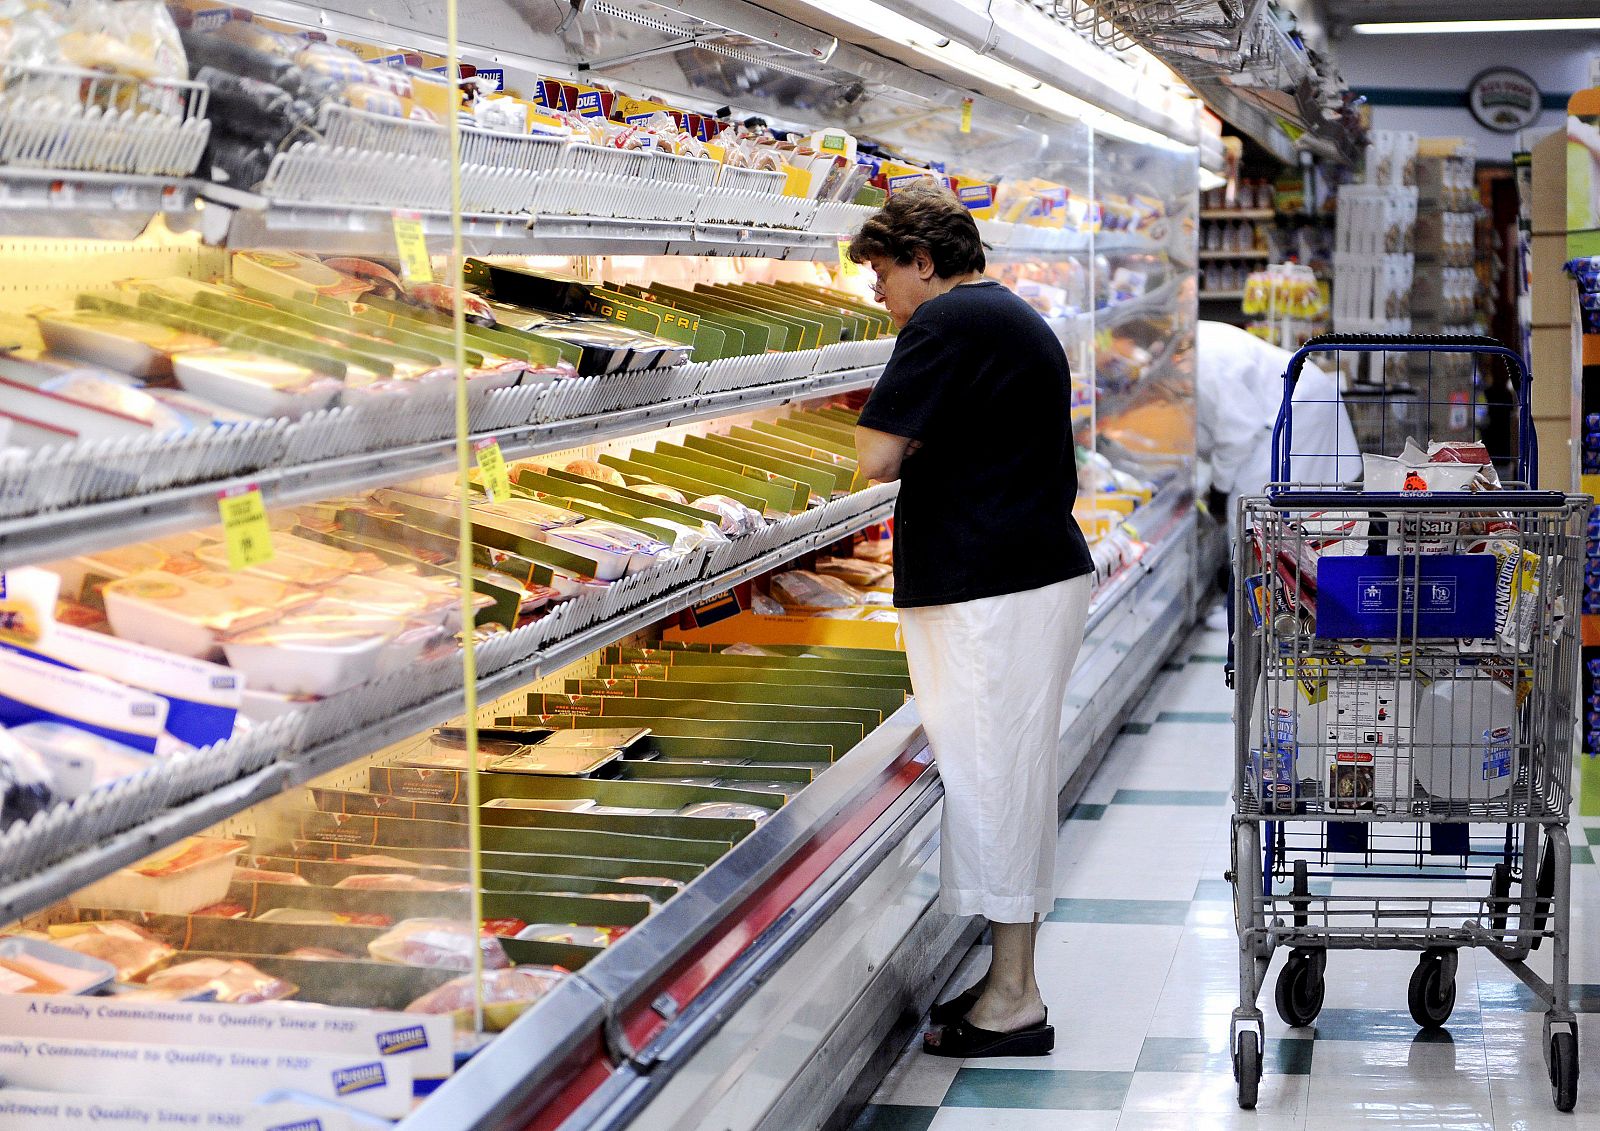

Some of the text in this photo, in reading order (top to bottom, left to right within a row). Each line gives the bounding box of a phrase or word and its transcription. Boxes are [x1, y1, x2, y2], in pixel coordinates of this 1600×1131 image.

[27, 1001, 38, 1013] A
[43, 1002, 91, 1019] Family
[97, 1005, 193, 1022] Commitment
[218, 1012, 274, 1029] Quality
[279, 1015, 318, 1029] Since
[36, 1043, 138, 1060] Commitment
[164, 1050, 224, 1066] Quality
[230, 1053, 271, 1066] Since
[88, 1105, 150, 1123] Quality
[158, 1109, 200, 1123] Since
